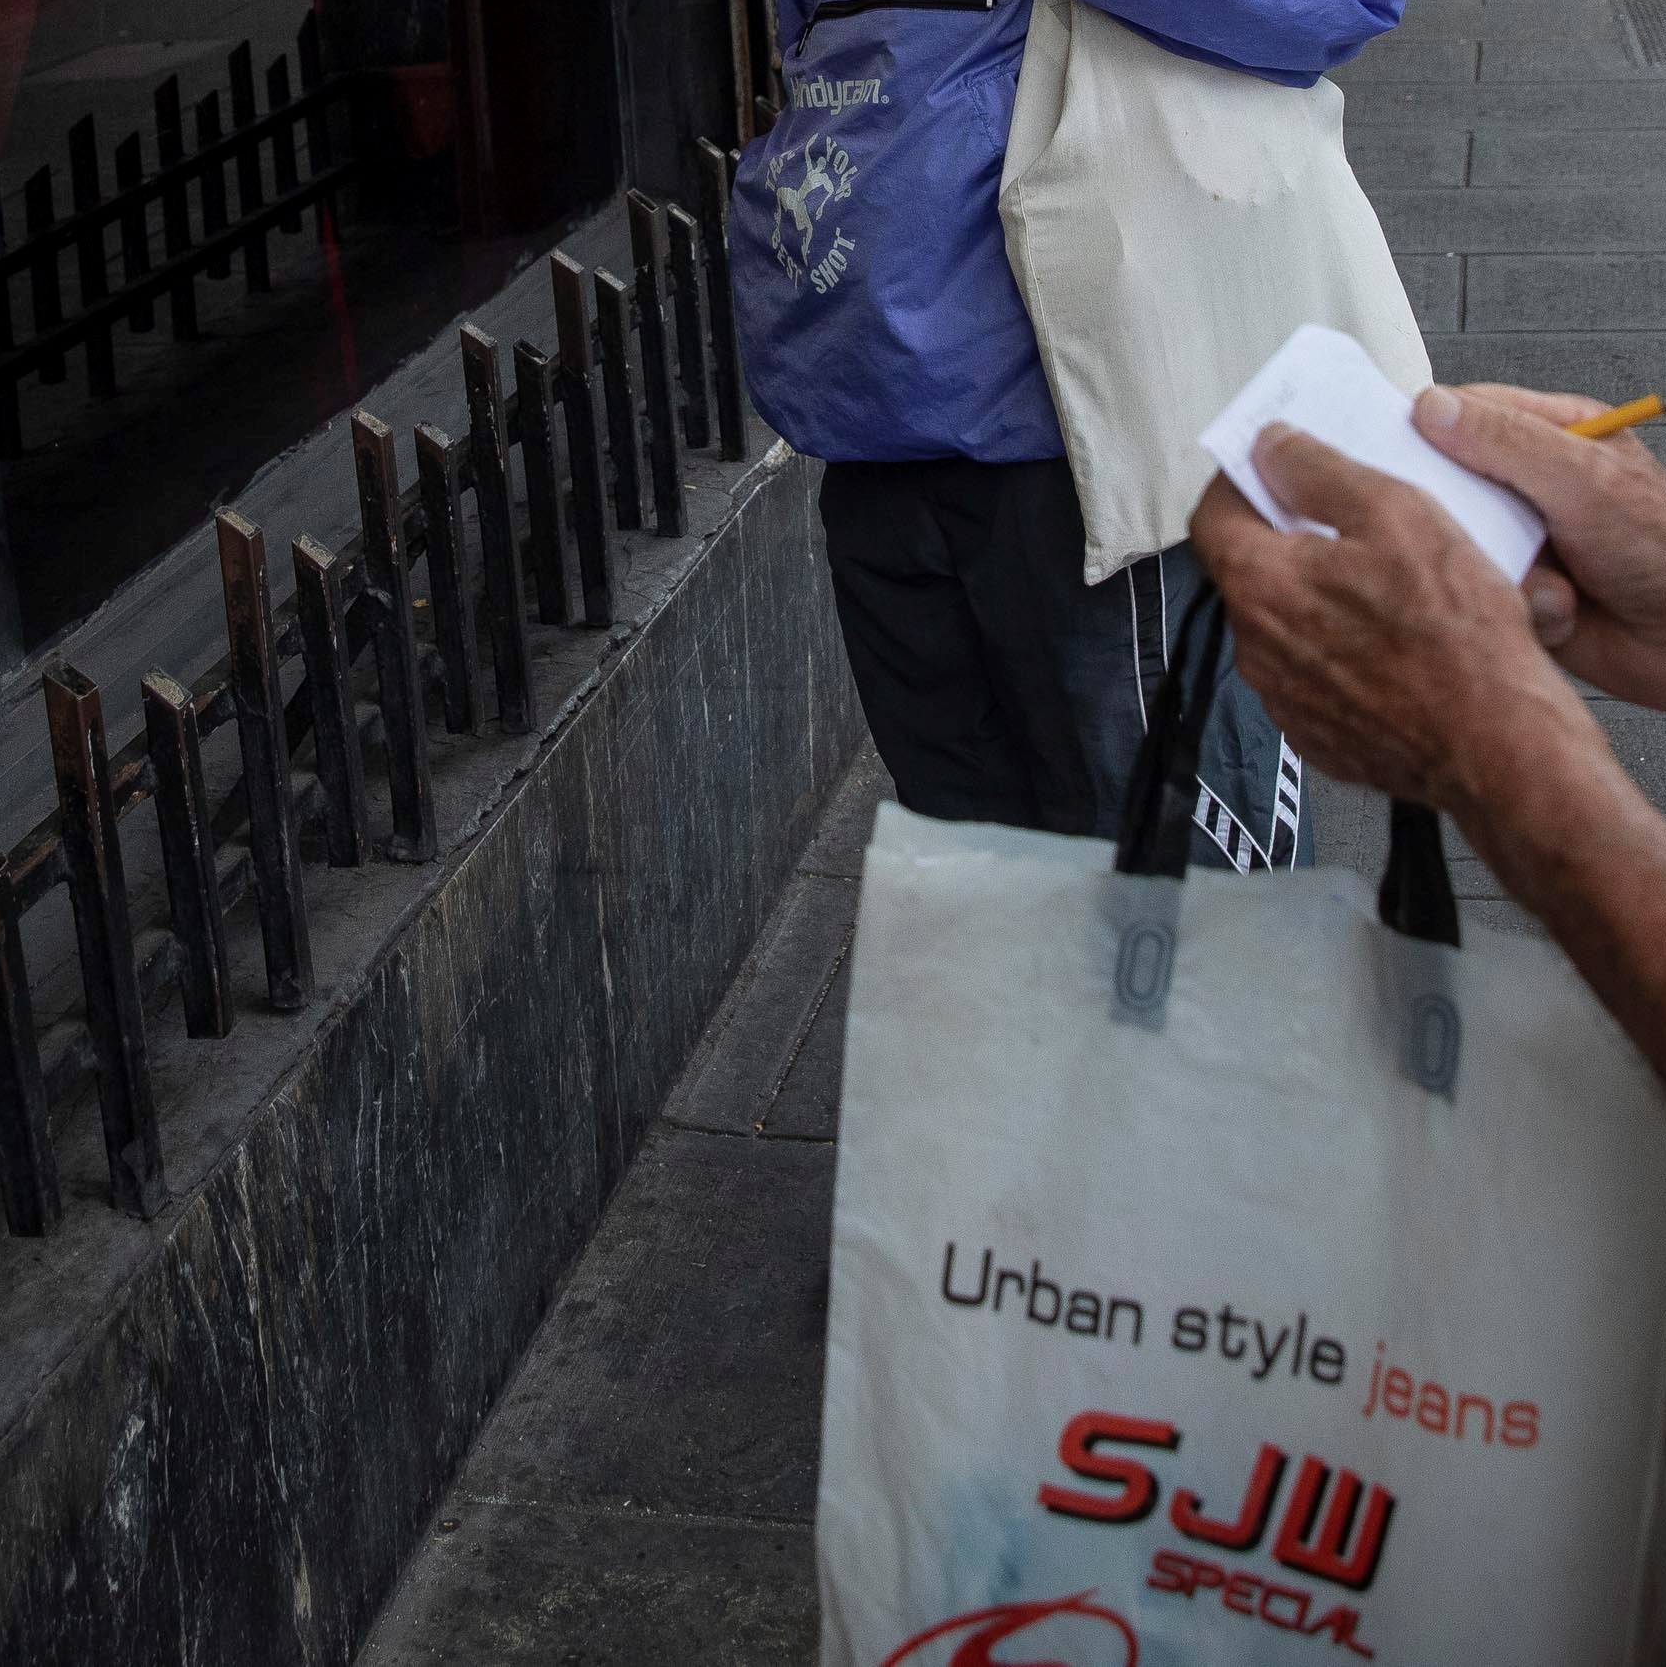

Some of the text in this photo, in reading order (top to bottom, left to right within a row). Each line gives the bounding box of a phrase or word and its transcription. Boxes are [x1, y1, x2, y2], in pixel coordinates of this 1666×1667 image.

[942, 1241, 1542, 1450] Urban style jeans
[1145, 1548, 1375, 1661] SPECIAL
